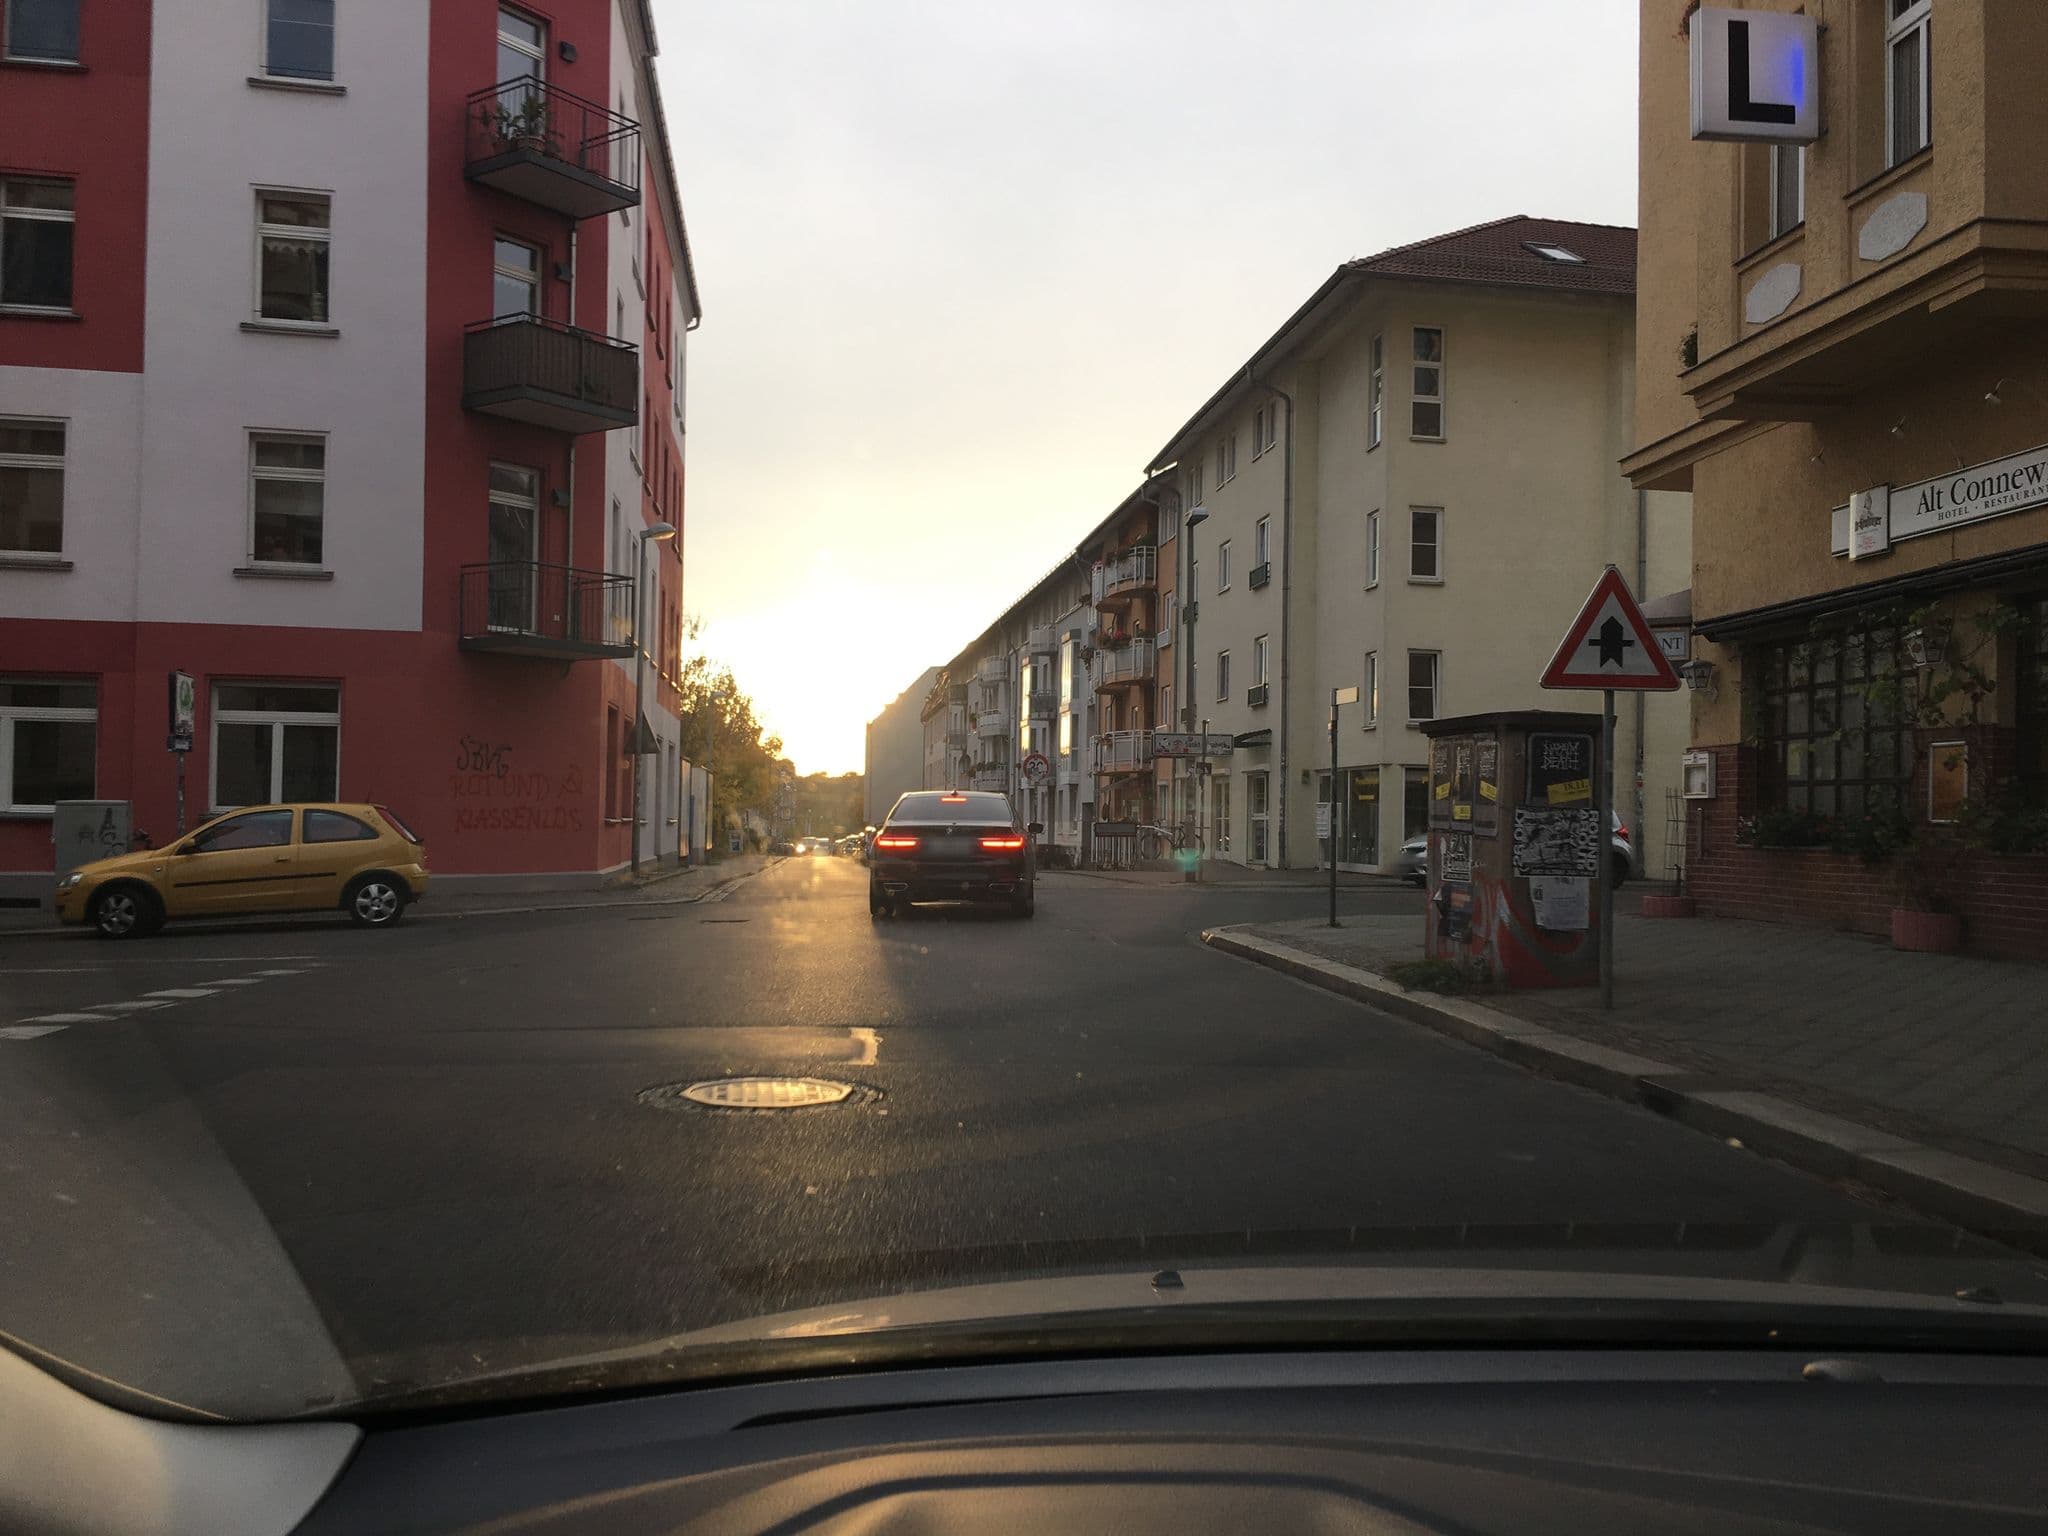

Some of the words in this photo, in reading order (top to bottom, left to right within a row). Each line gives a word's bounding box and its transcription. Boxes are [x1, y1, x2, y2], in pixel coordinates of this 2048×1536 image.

[1728, 20, 1795, 124] L
[1916, 485, 1944, 516] Alt
[1950, 462, 2048, 505] Connew
[1937, 505, 1970, 521] HOTEL
[1661, 637, 1681, 649] NT
